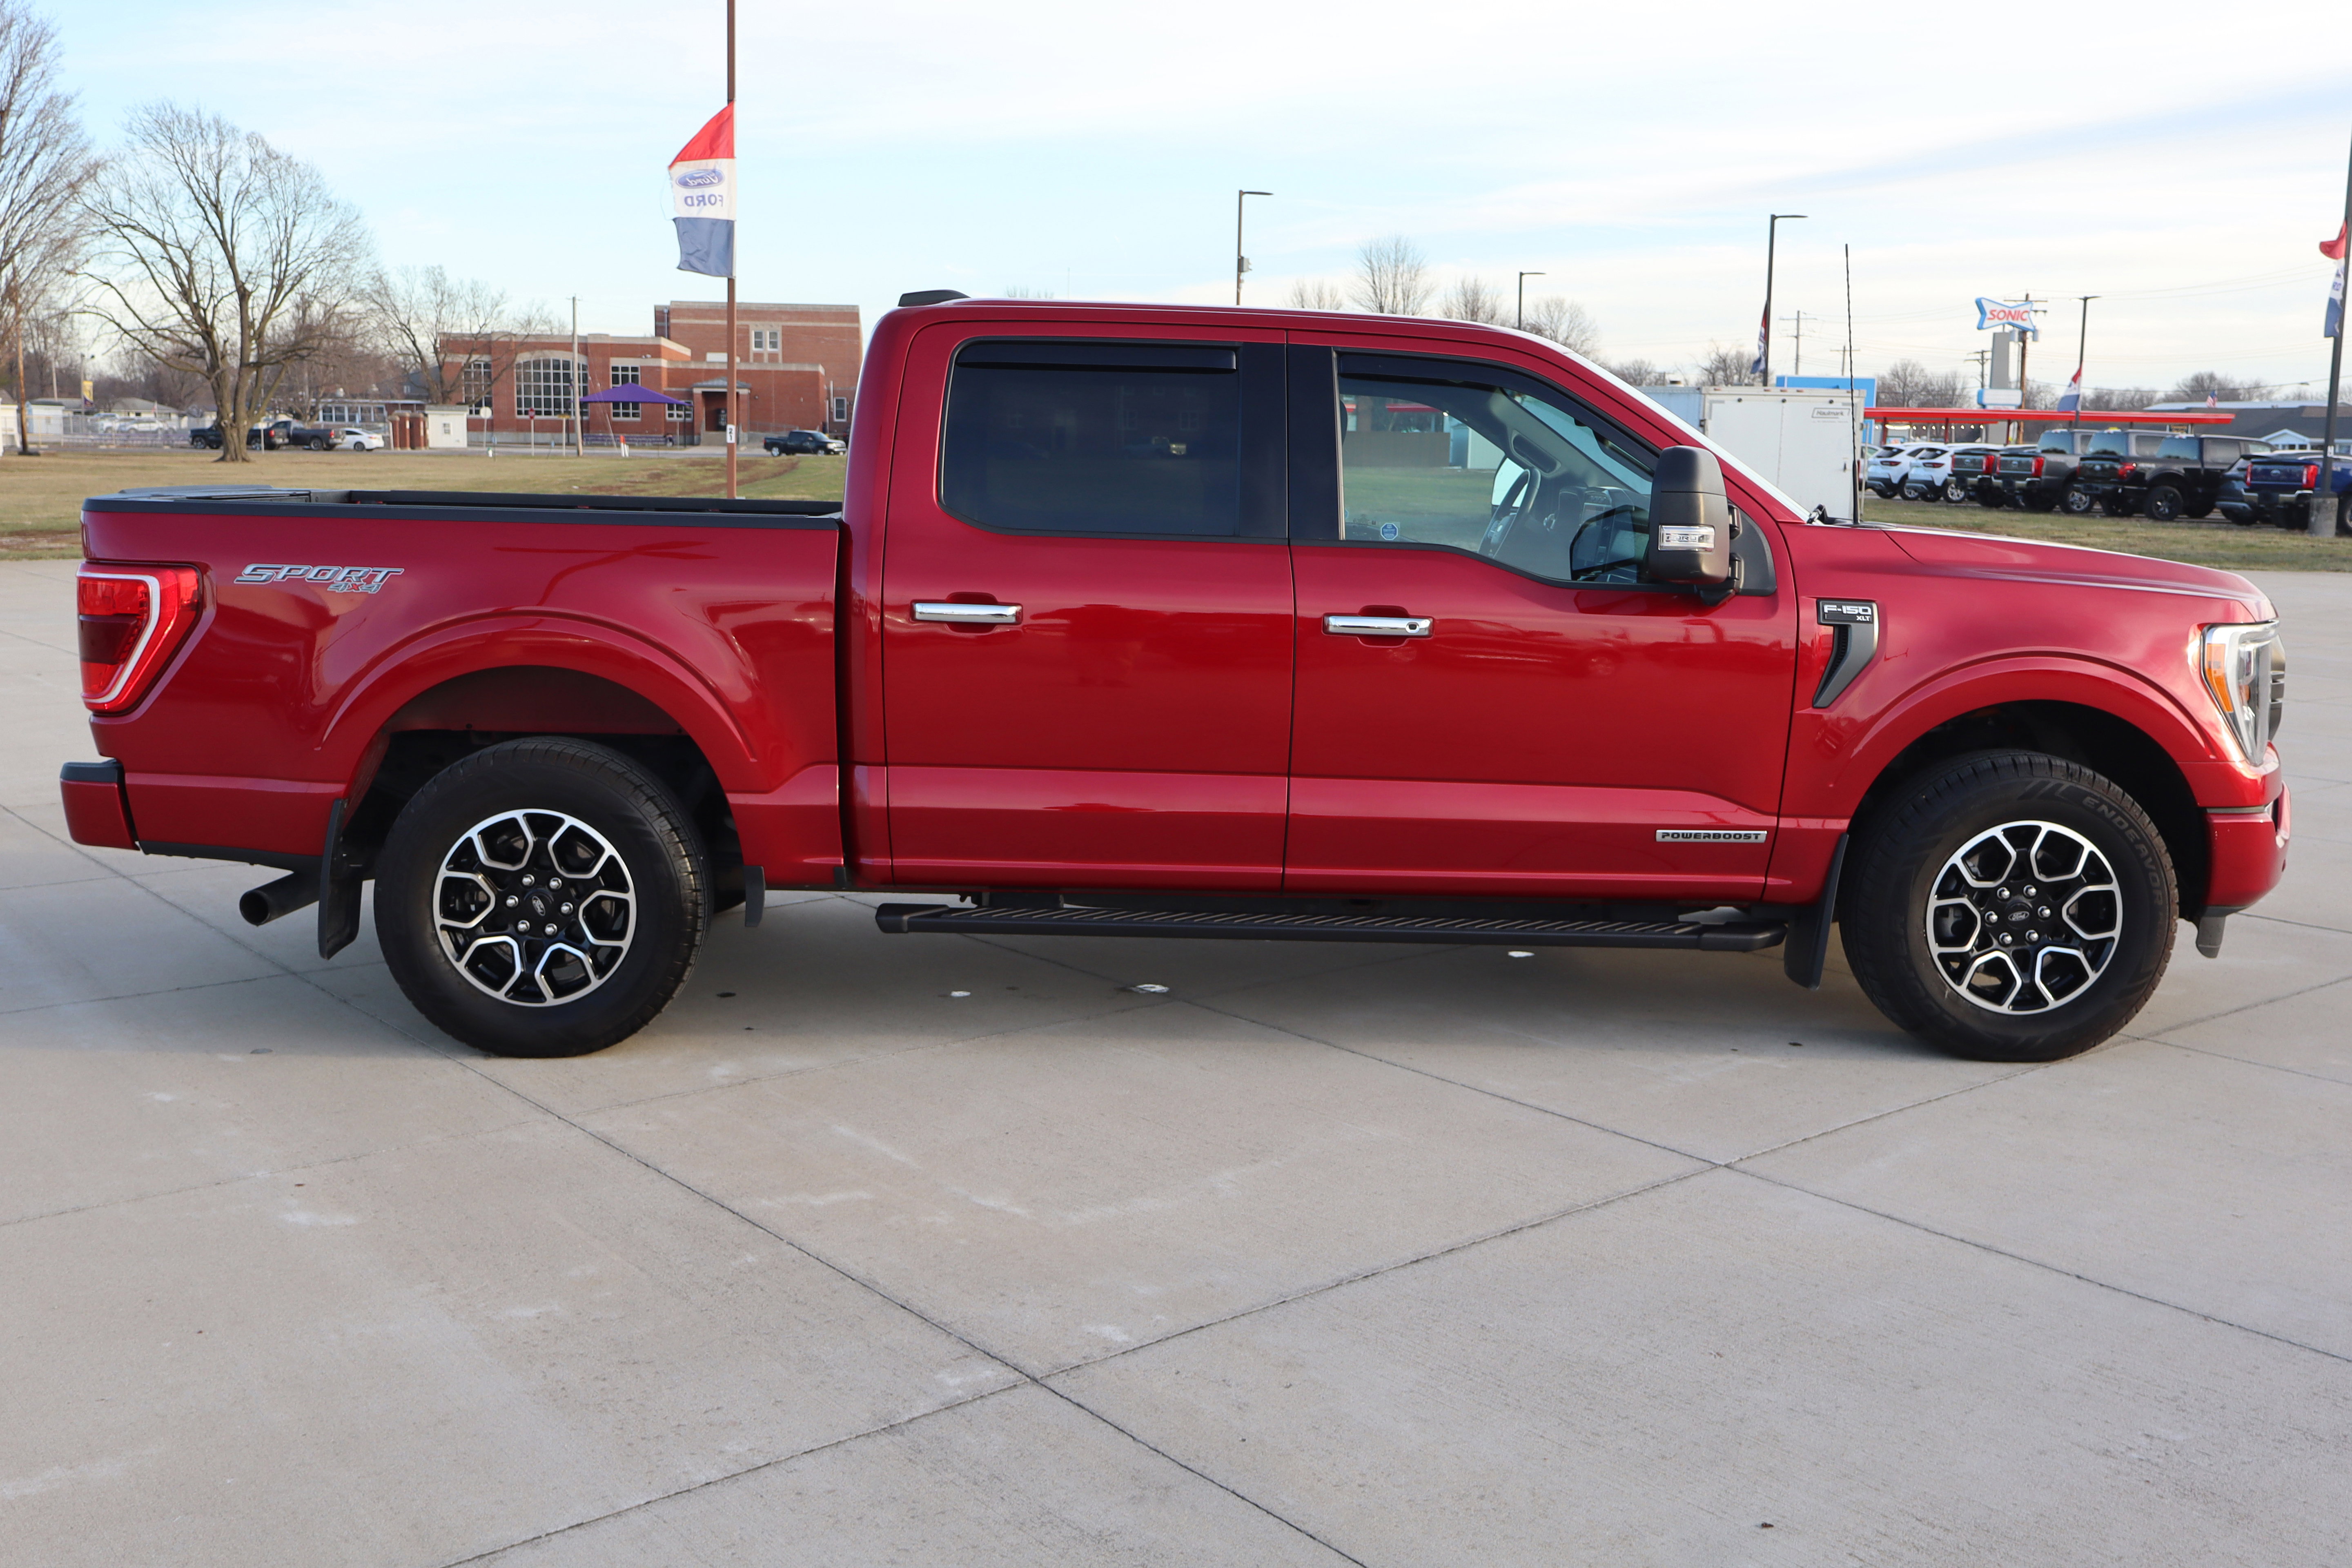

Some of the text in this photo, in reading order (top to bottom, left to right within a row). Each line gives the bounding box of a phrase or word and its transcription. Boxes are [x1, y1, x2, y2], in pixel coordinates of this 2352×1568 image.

[1987, 309, 2029, 321] SONIC
[234, 564, 404, 584] SPORT
[1823, 604, 1872, 615] F-150
[1662, 832, 1761, 840] POWERBOOST
